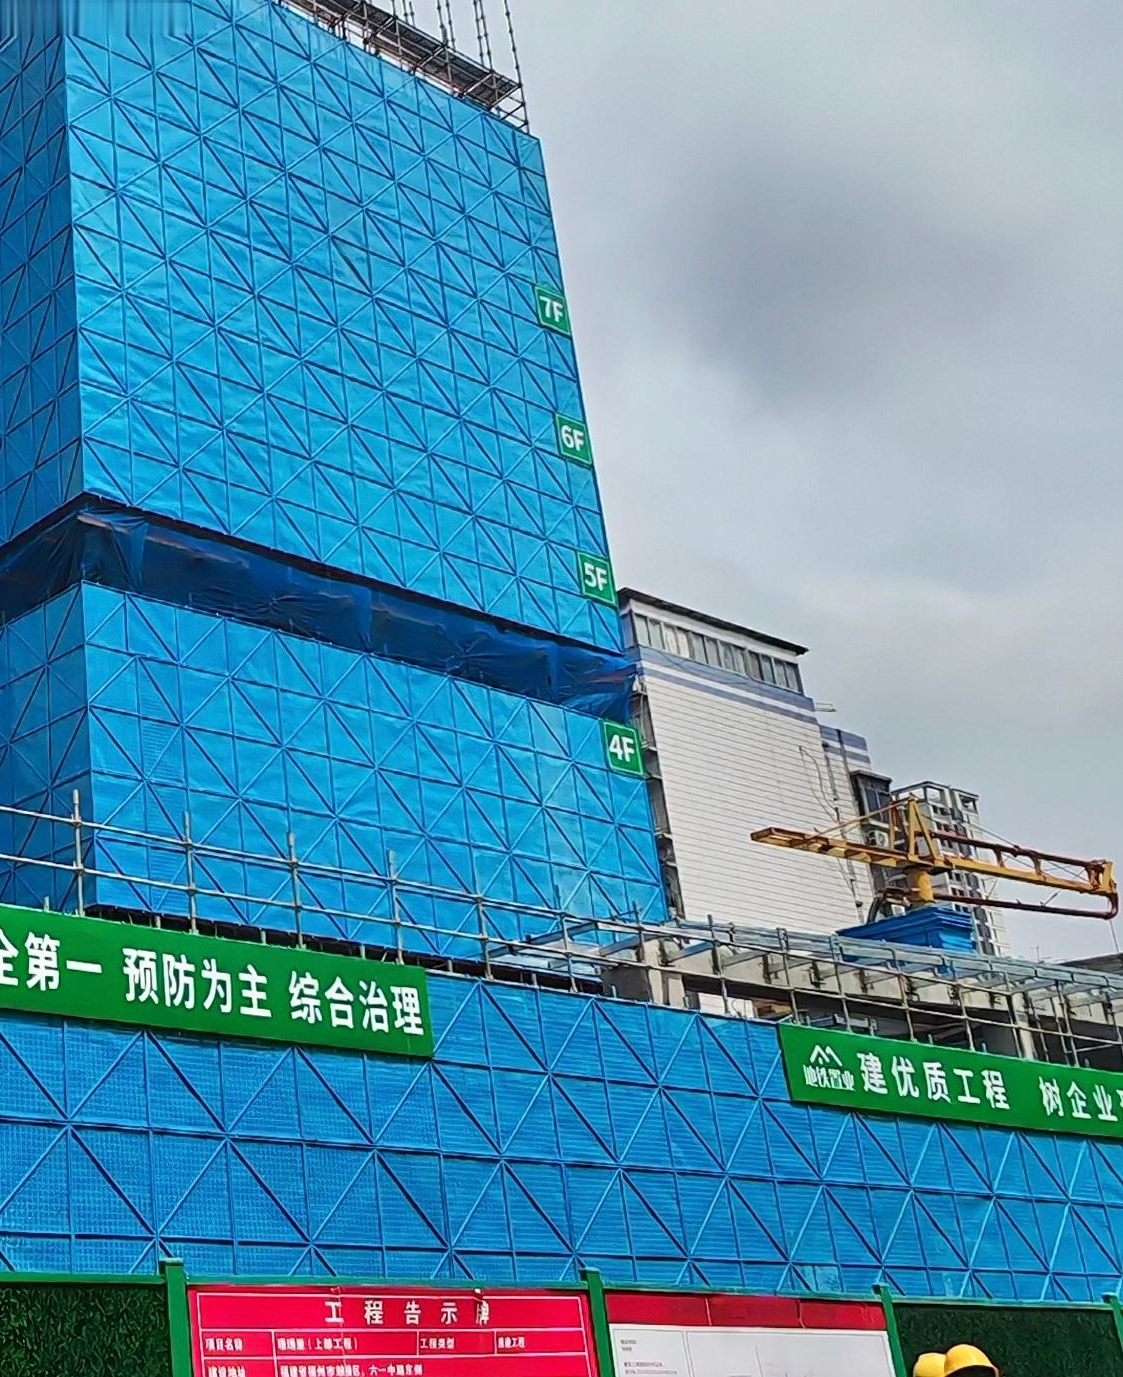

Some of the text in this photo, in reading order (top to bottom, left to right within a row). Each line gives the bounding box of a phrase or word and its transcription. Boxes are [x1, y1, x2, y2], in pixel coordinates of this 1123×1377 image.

[539, 295, 564, 323] 7F
[560, 424, 585, 451] 6F
[583, 562, 608, 591] 5F
[609, 734, 636, 763] 4F
[122, 946, 272, 1019] 预防为主
[288, 969, 424, 1036] 综合治理
[803, 1063, 856, 1092] 地铁置业
[856, 1051, 1011, 1111] 建优质工程
